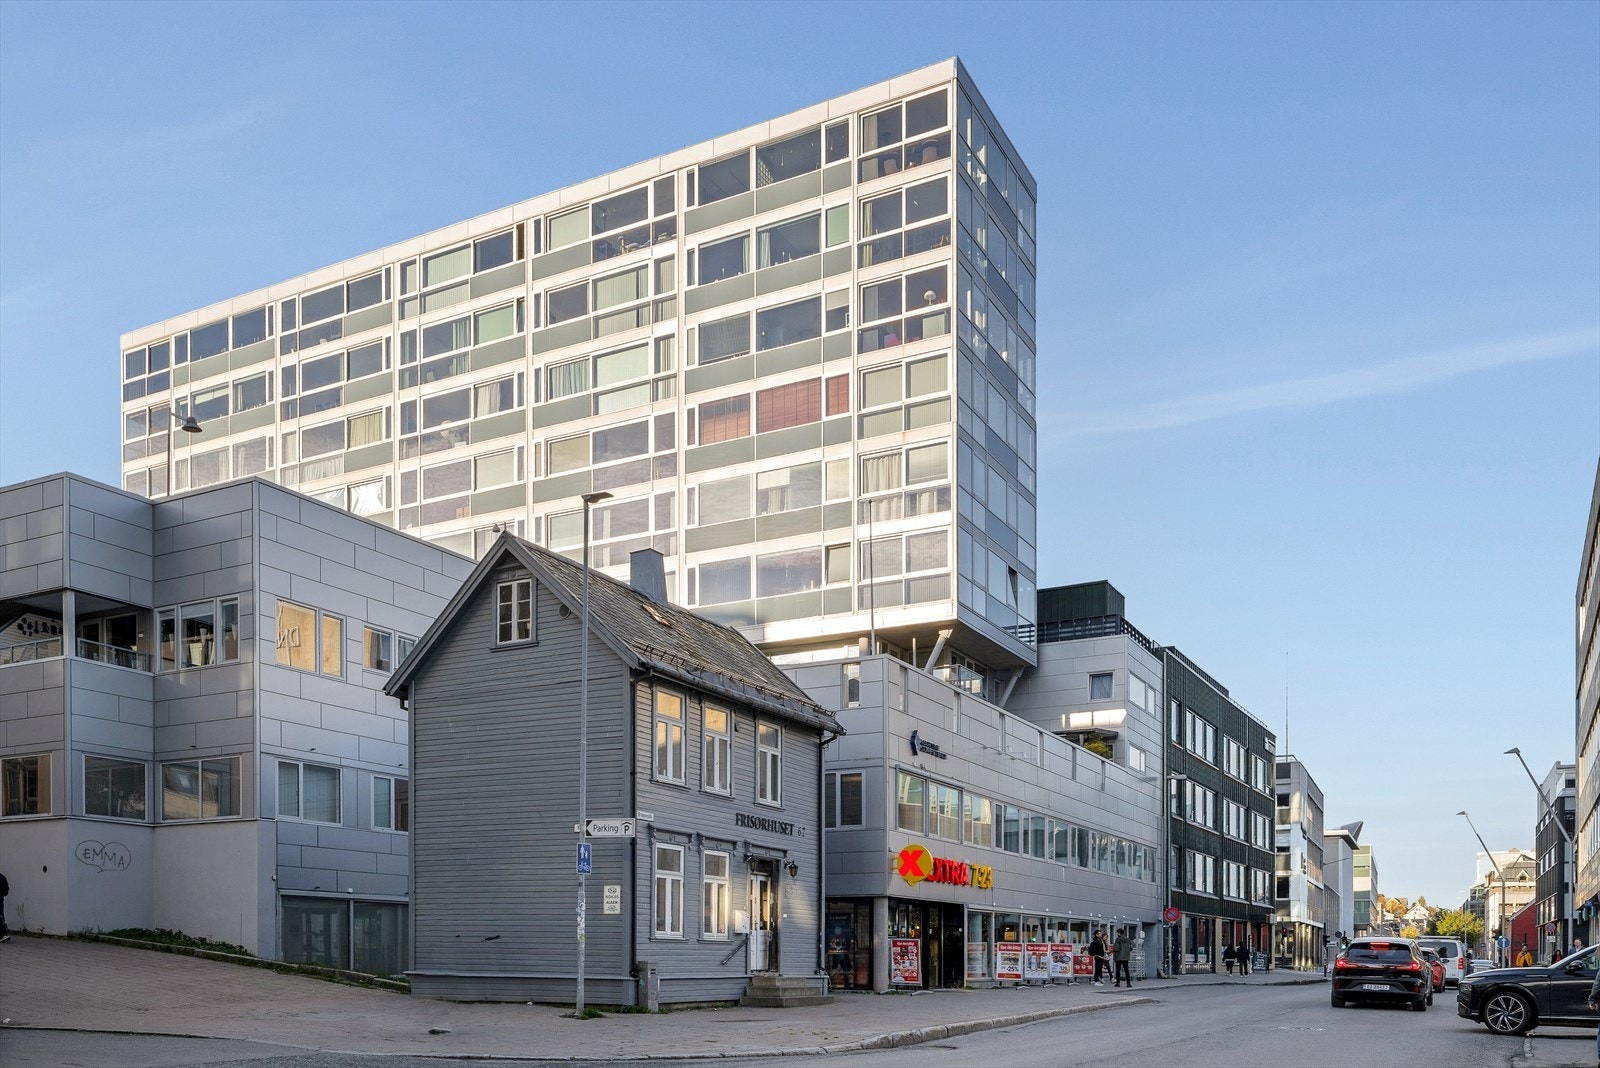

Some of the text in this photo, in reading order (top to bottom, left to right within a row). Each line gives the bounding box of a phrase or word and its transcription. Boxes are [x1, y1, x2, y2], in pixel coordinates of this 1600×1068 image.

[593, 824, 619, 834] Parking
[735, 812, 794, 836] FRISØRHUSET
[82, 848, 125, 869] EMMA
[926, 857, 969, 886] XTRA
